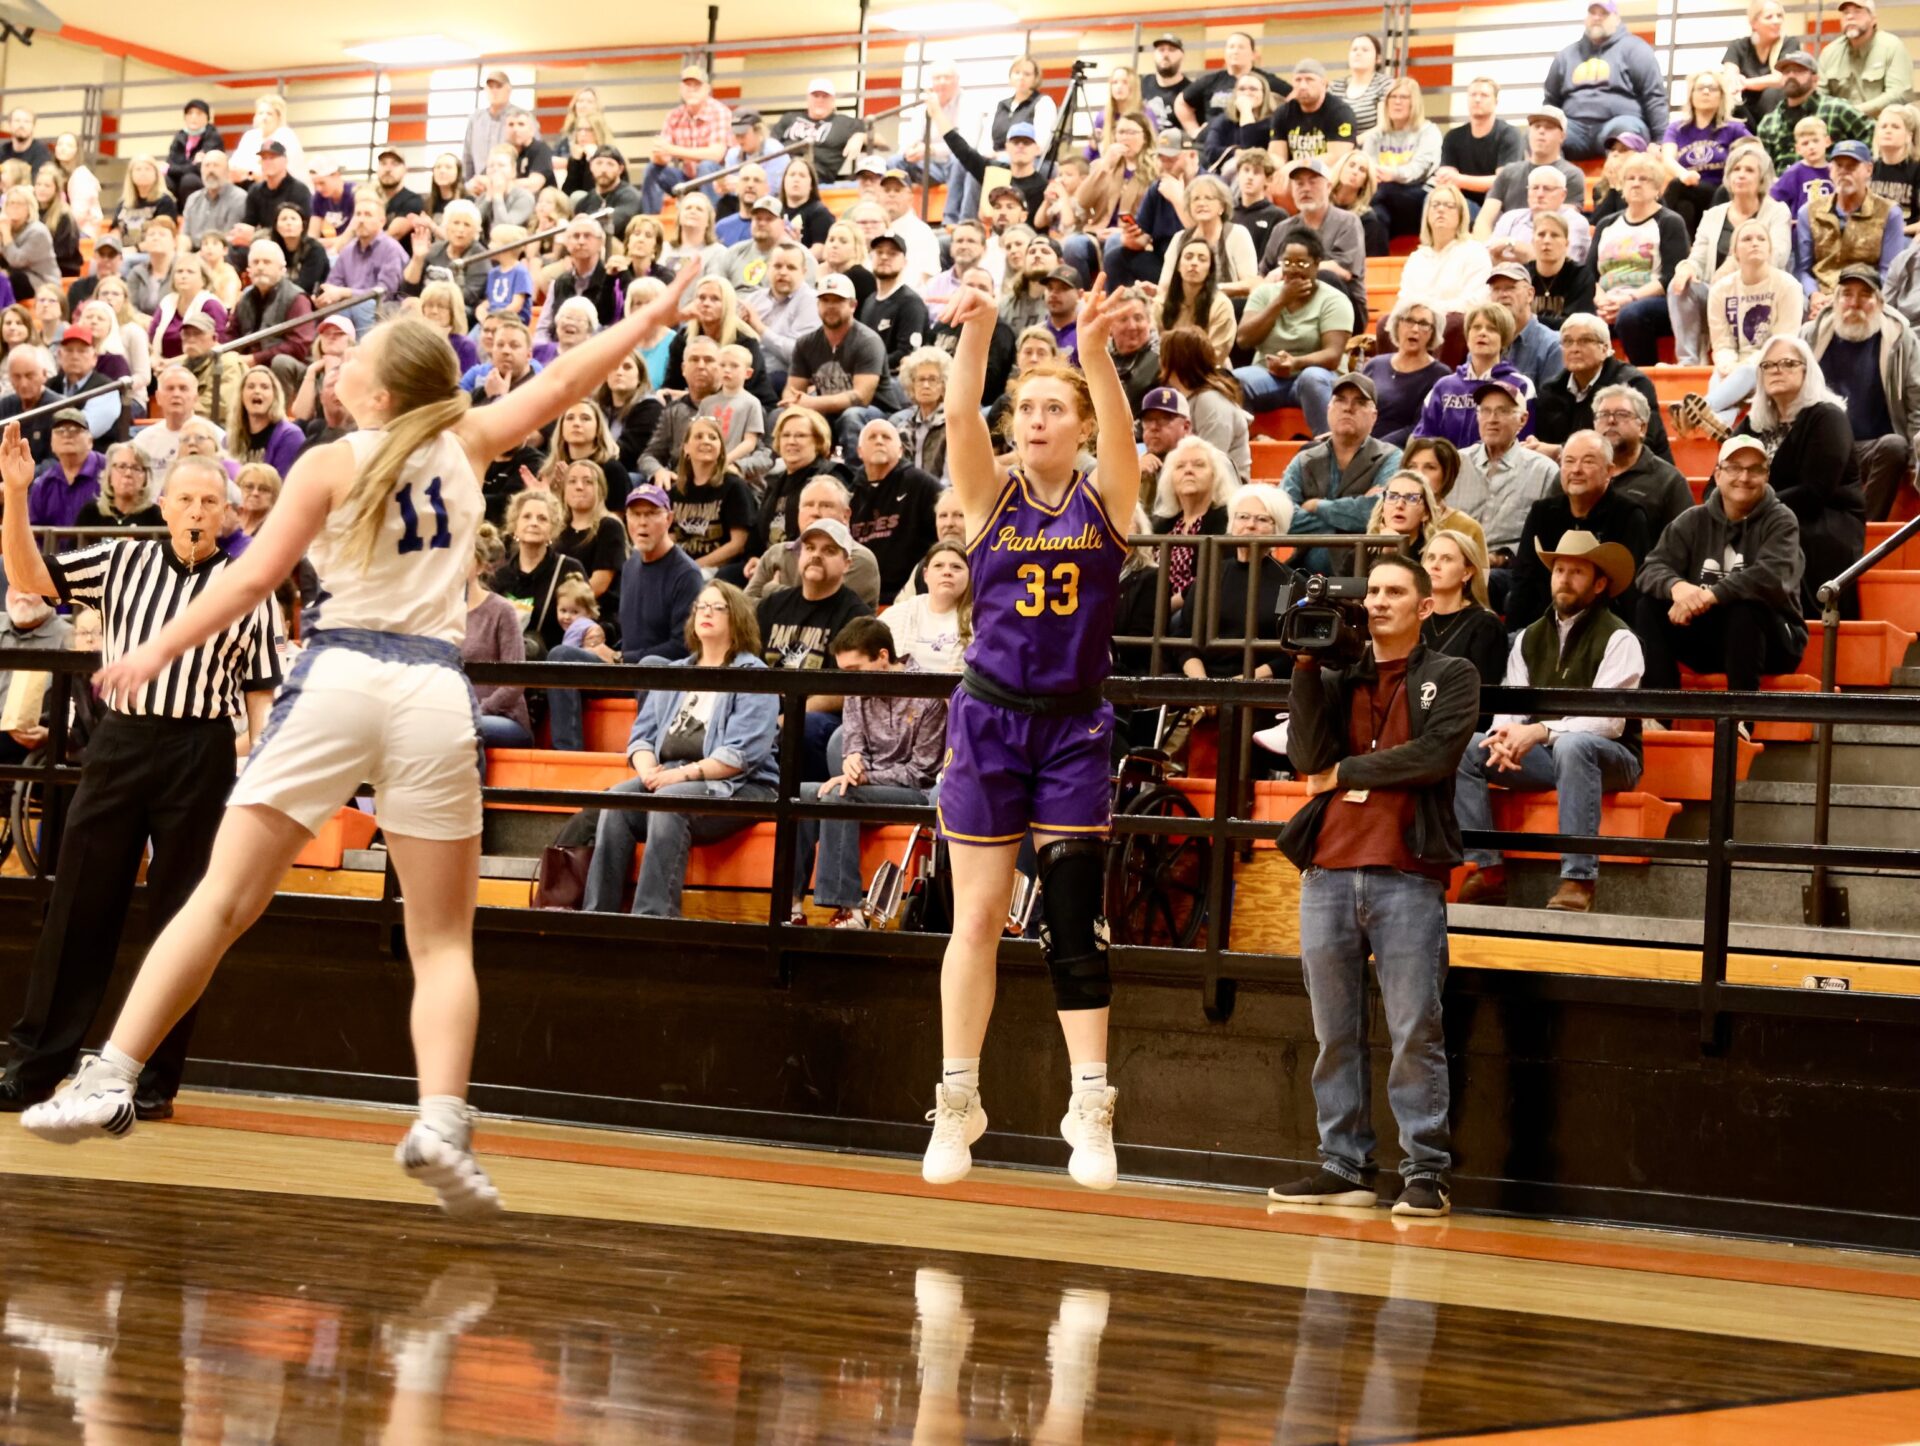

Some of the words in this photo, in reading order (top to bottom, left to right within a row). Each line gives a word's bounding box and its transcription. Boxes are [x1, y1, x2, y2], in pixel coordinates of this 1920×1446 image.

[395, 475, 452, 555] 11
[991, 523, 1102, 552] Panhandle
[1016, 562, 1080, 617] 33
